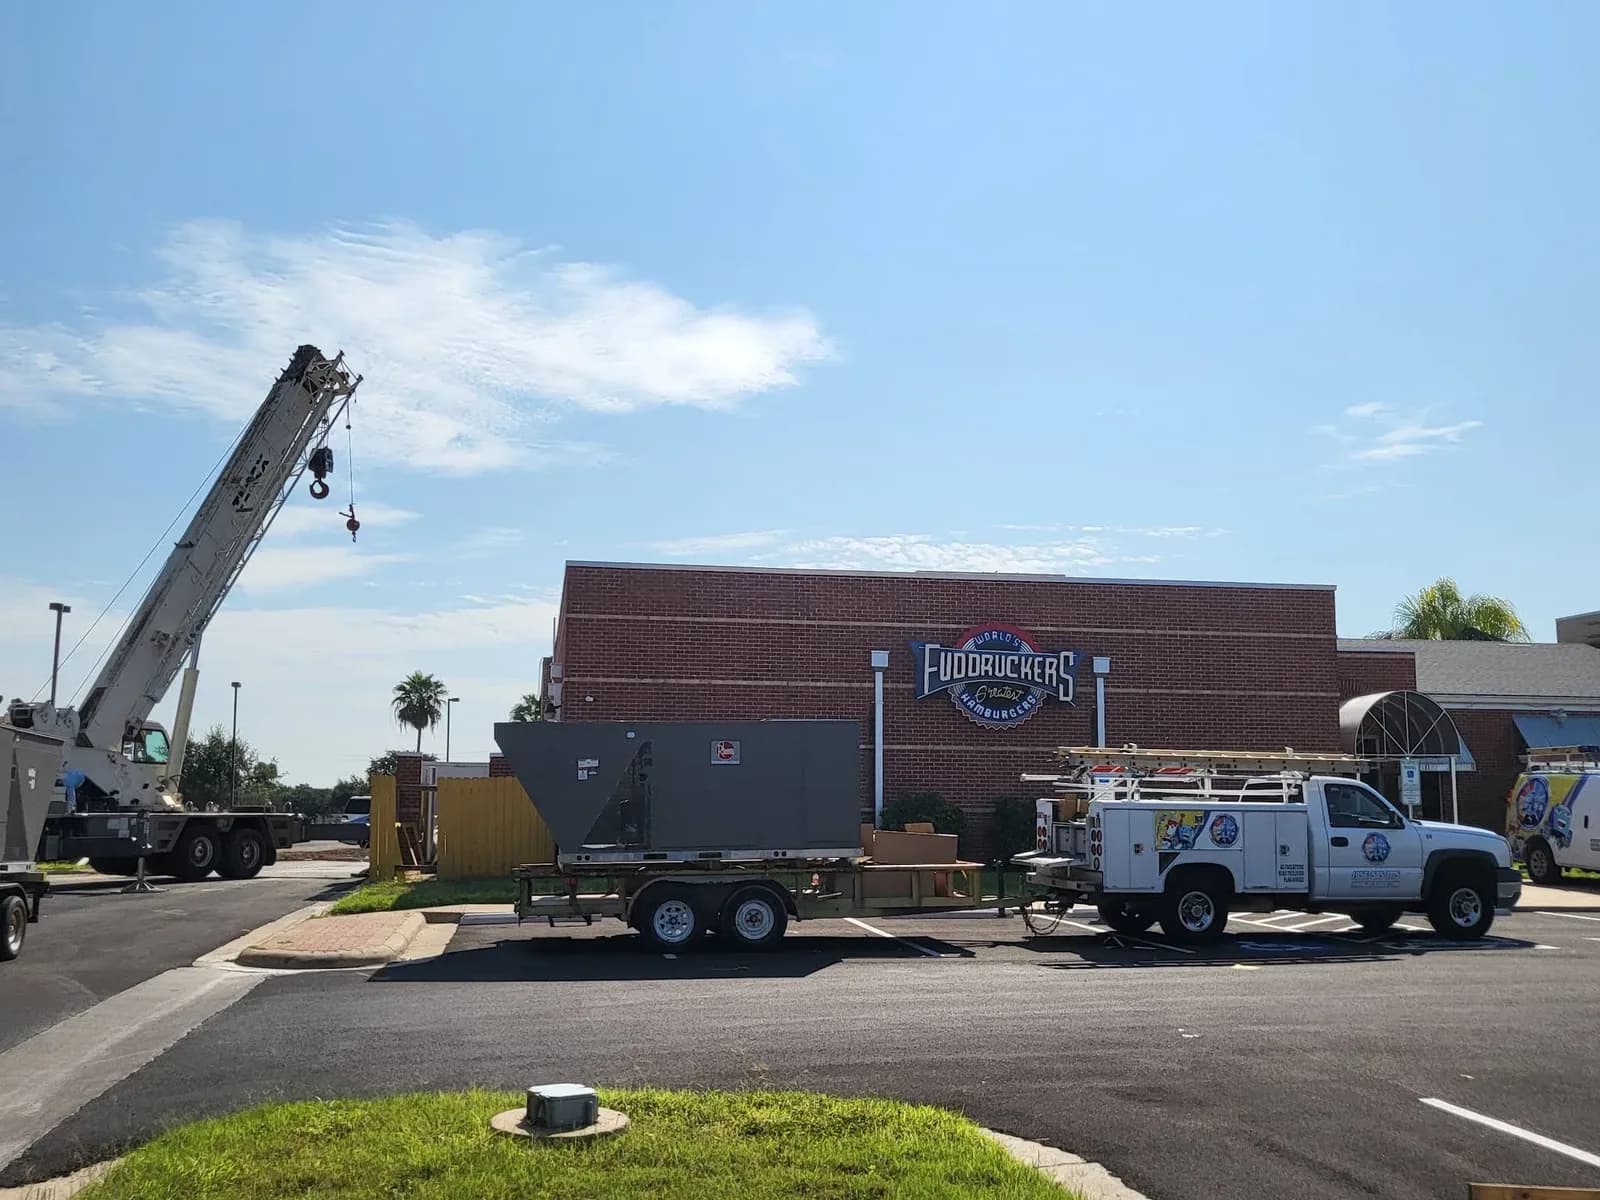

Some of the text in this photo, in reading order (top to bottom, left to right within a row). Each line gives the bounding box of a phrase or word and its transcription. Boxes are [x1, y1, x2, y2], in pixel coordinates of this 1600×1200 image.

[974, 631, 1021, 646] WORLD'S
[924, 643, 1074, 702] FUDDRUCKERS
[975, 685, 1025, 703] Greatest
[961, 692, 1036, 719] HAMBURGERS
